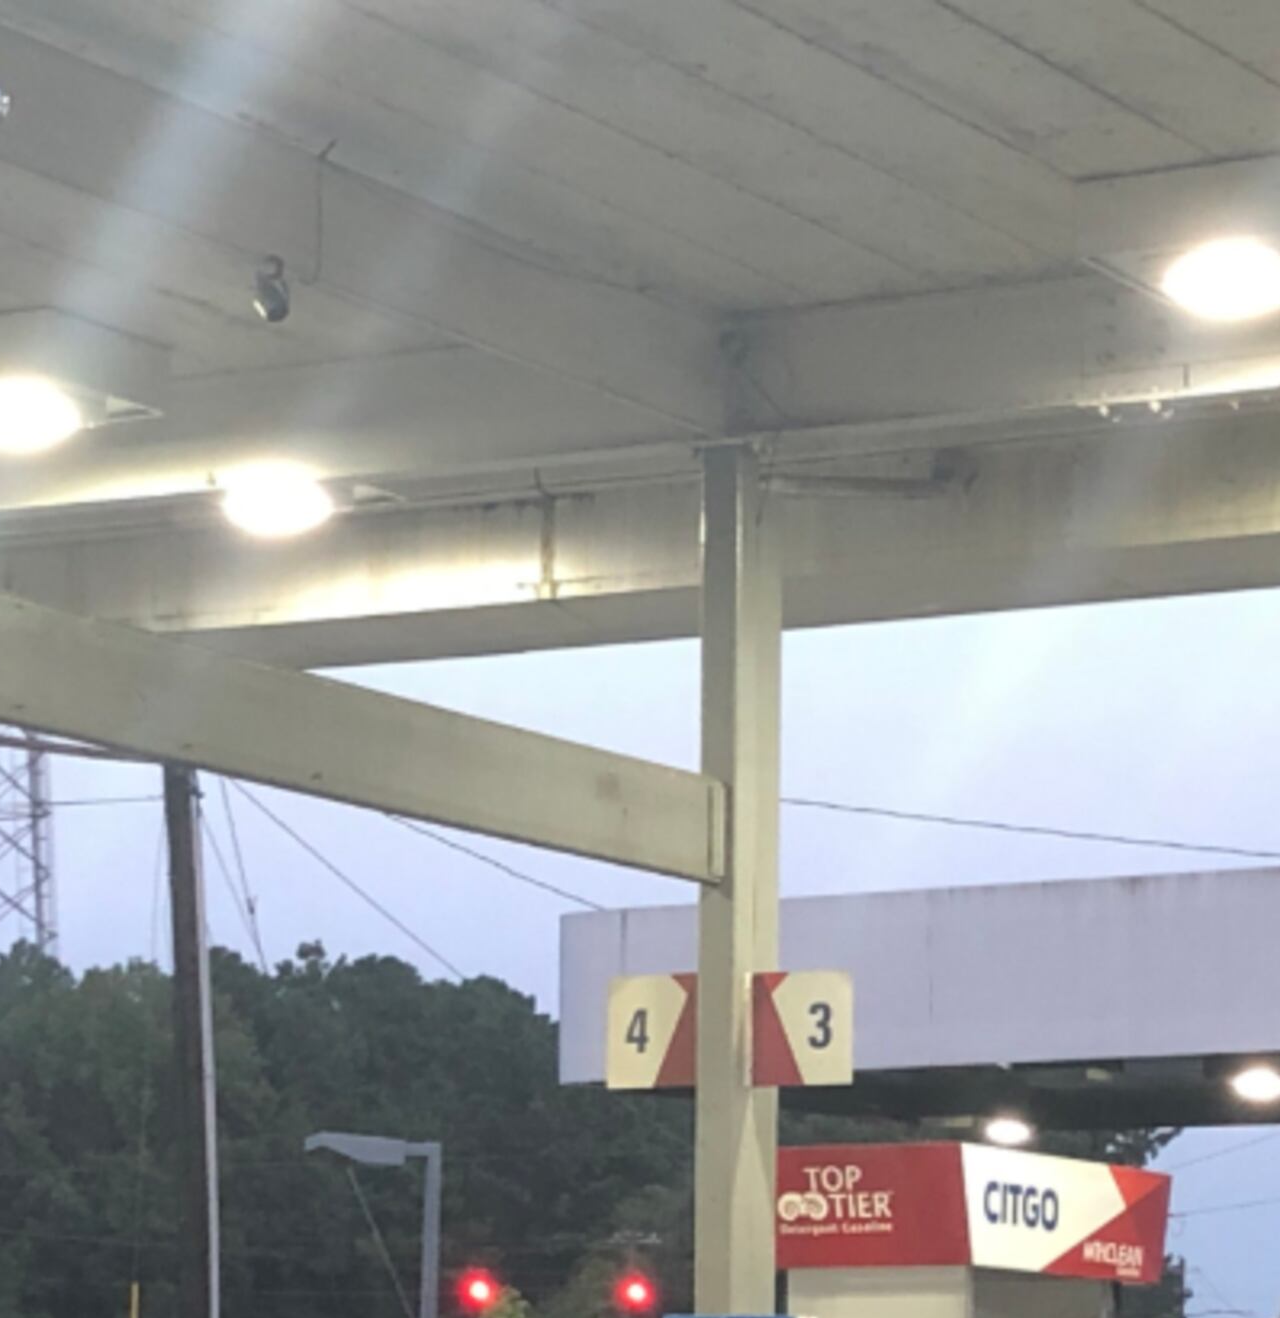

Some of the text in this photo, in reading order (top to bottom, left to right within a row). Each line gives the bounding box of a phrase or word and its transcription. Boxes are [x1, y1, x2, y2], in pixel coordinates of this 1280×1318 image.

[625, 1007, 650, 1054] 4
[807, 1002, 832, 1050] 3
[802, 1164, 863, 1193] TOP
[827, 1192, 893, 1219] TIER
[982, 1180, 1060, 1232] CITGO
